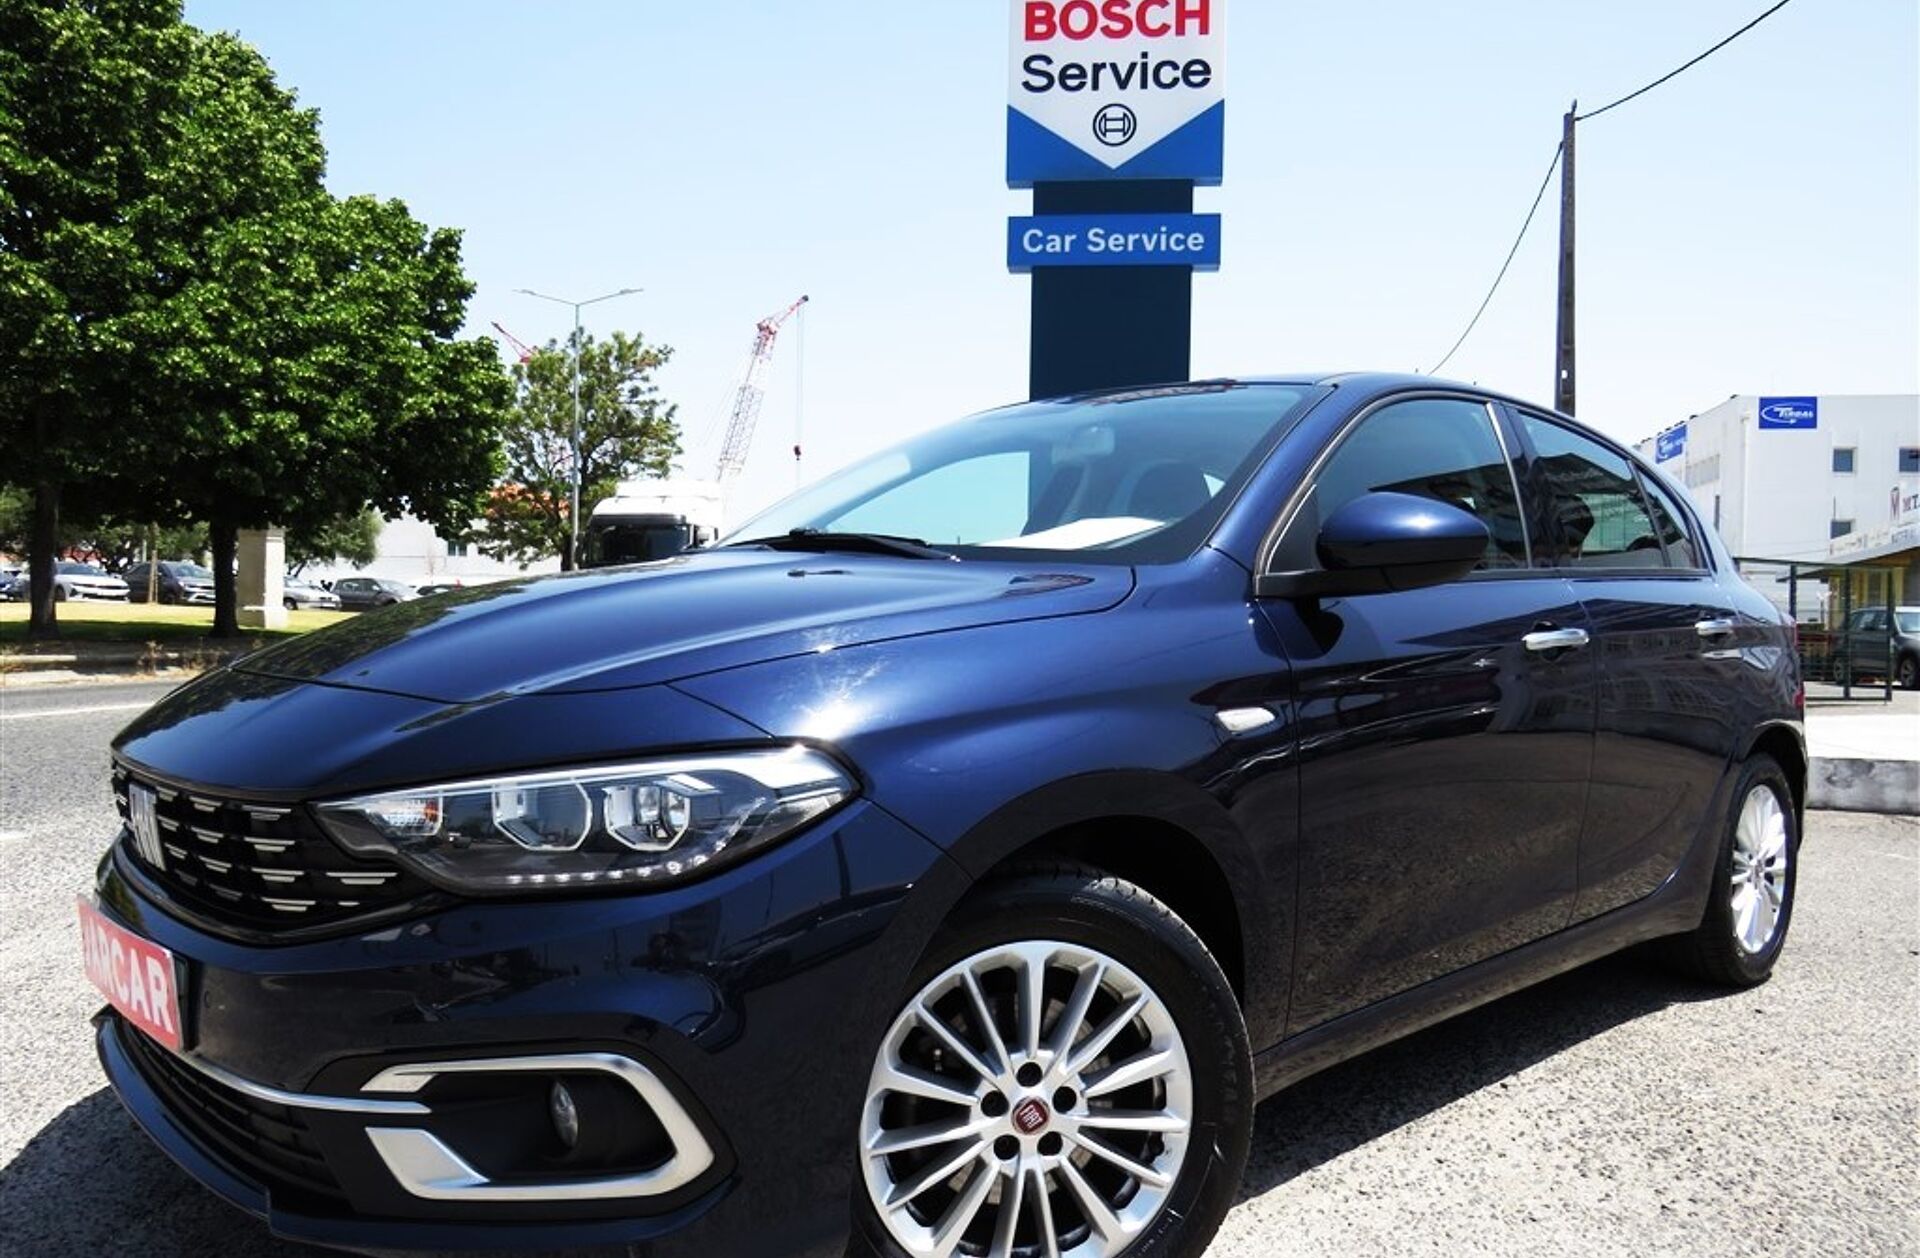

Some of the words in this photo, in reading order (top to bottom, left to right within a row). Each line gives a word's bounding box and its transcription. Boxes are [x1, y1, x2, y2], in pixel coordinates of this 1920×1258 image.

[1024, 0, 1210, 41] BOSCH
[1021, 51, 1212, 93] Service
[1022, 228, 1077, 253] Car
[1087, 226, 1205, 252] Service
